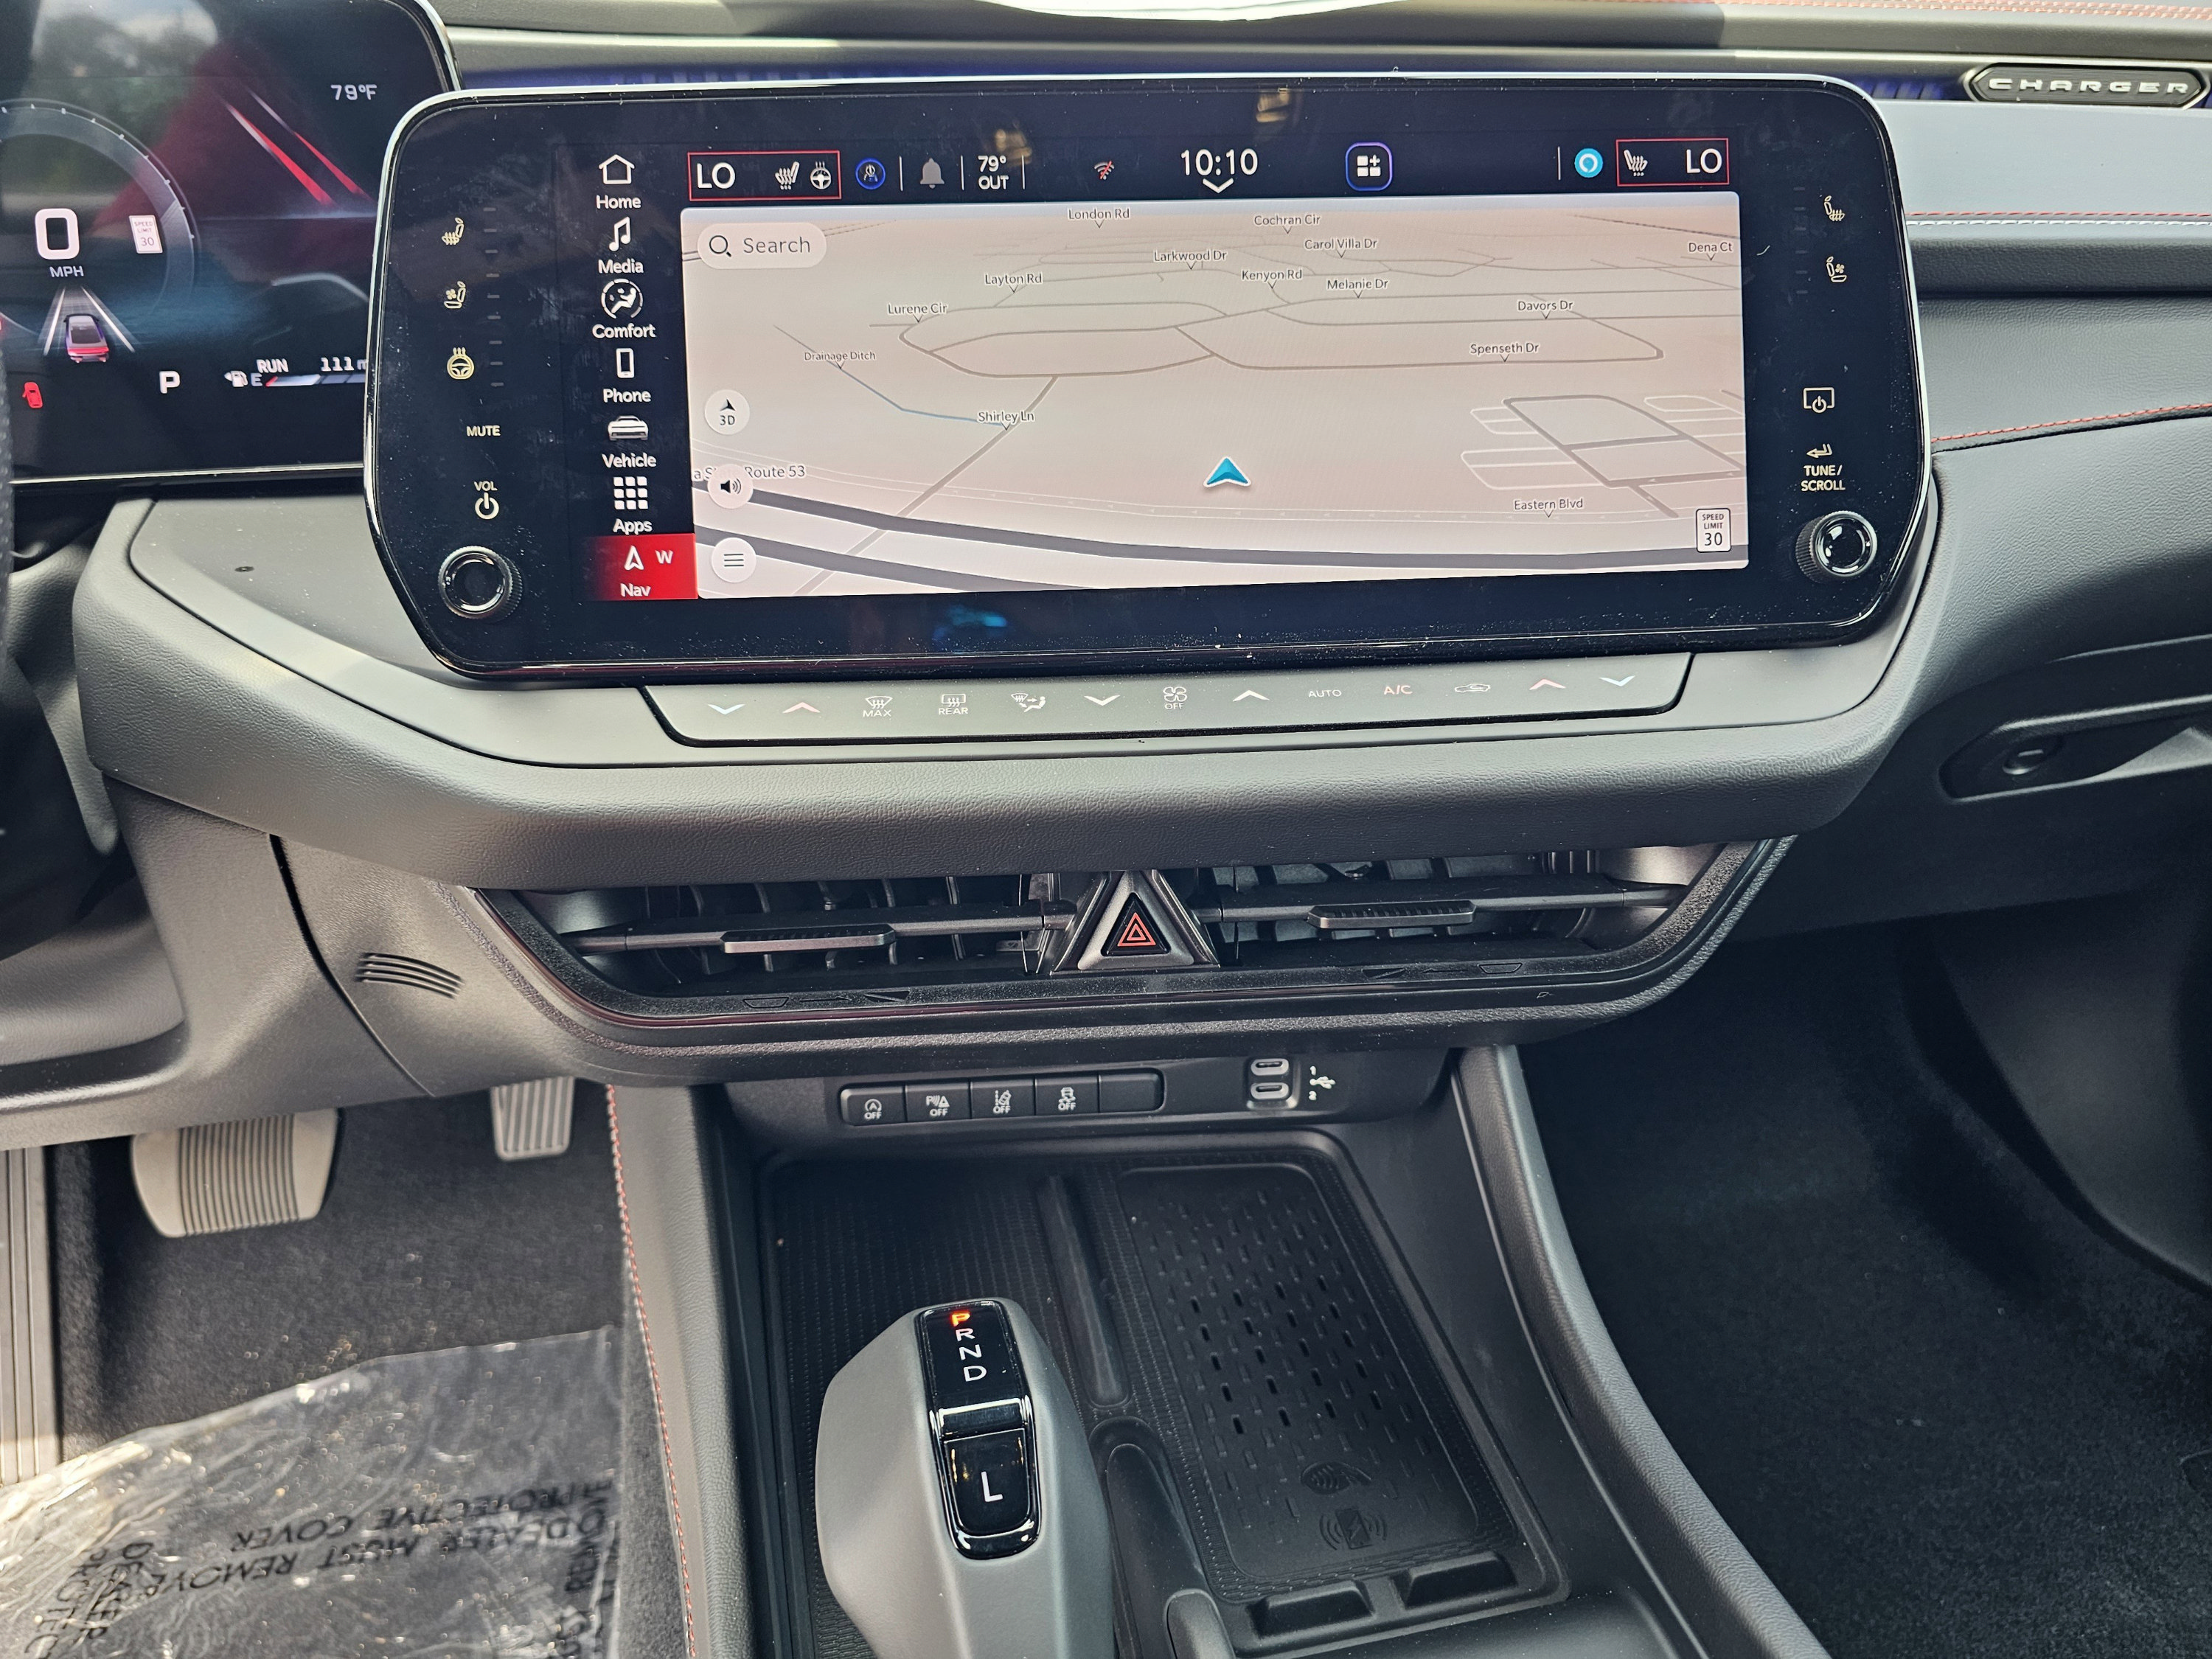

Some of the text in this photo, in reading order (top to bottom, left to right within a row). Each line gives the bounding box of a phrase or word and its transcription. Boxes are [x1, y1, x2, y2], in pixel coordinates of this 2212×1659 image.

[1988, 77, 2189, 94] CHARGER
[330, 84, 377, 101] 79°F
[978, 156, 1006, 173] 79°
[1181, 148, 1259, 176] 10:10
[1686, 148, 1722, 174] LO
[696, 162, 736, 189] LO
[978, 175, 1009, 189] OUT
[596, 195, 641, 209] Home
[1068, 208, 1130, 220] London Rd
[1253, 214, 1321, 226] Cochran Cir
[35, 208, 80, 260] 0
[141, 237, 154, 246] 30
[743, 236, 811, 254] Search
[1304, 238, 1377, 250] Carol Villa Dr
[1688, 241, 1733, 253] Dena Ct
[1154, 250, 1227, 262] Larkwood Dr
[49, 265, 84, 277] MPH
[598, 260, 644, 274] Media
[985, 272, 1043, 286] Layton Rd
[1242, 268, 1303, 282] Kenyon Rd
[1327, 279, 1389, 291] Melanie Dr
[888, 303, 947, 315] Lurene Cir
[1518, 300, 1573, 312] Davors Dr
[592, 324, 655, 338] Comfort
[1470, 342, 1539, 355] Spenseth Dr
[804, 350, 876, 362] Drainage Ditch
[257, 358, 288, 373] RUN
[321, 357, 354, 372] 111
[160, 371, 179, 393] P
[250, 372, 262, 386] E
[602, 389, 651, 403] Phone
[720, 414, 736, 425] 3D
[978, 410, 1034, 424] Shirley Ln
[466, 425, 501, 437] MUTE
[602, 453, 657, 468] Vehicle
[789, 465, 805, 477] 53
[474, 481, 497, 491] VOL
[1801, 479, 1846, 492] SCROLL
[1514, 498, 1583, 510] Eastern Blvd
[613, 519, 653, 535] Apps
[1704, 522, 1723, 530] LIMIT
[1704, 532, 1723, 547] 30
[656, 550, 673, 564] W
[621, 584, 651, 597] Nav
[1309, 689, 1341, 698] AUTO
[1382, 684, 1413, 695] A/C
[863, 709, 891, 717] MAX
[938, 706, 968, 715] REAR
[1310, 1066, 1315, 1075] 1
[1309, 1091, 1315, 1100] 2
[930, 1108, 948, 1117] OFF
[992, 1105, 1011, 1114] OFF
[1058, 1102, 1076, 1110] OFF
[863, 1111, 882, 1120] OFF
[952, 1312, 970, 1326] P
[956, 1328, 975, 1342] R
[959, 1344, 982, 1360] N
[964, 1366, 987, 1382] D
[981, 1472, 1004, 1502] L
[231, 1517, 354, 1554] COVER
